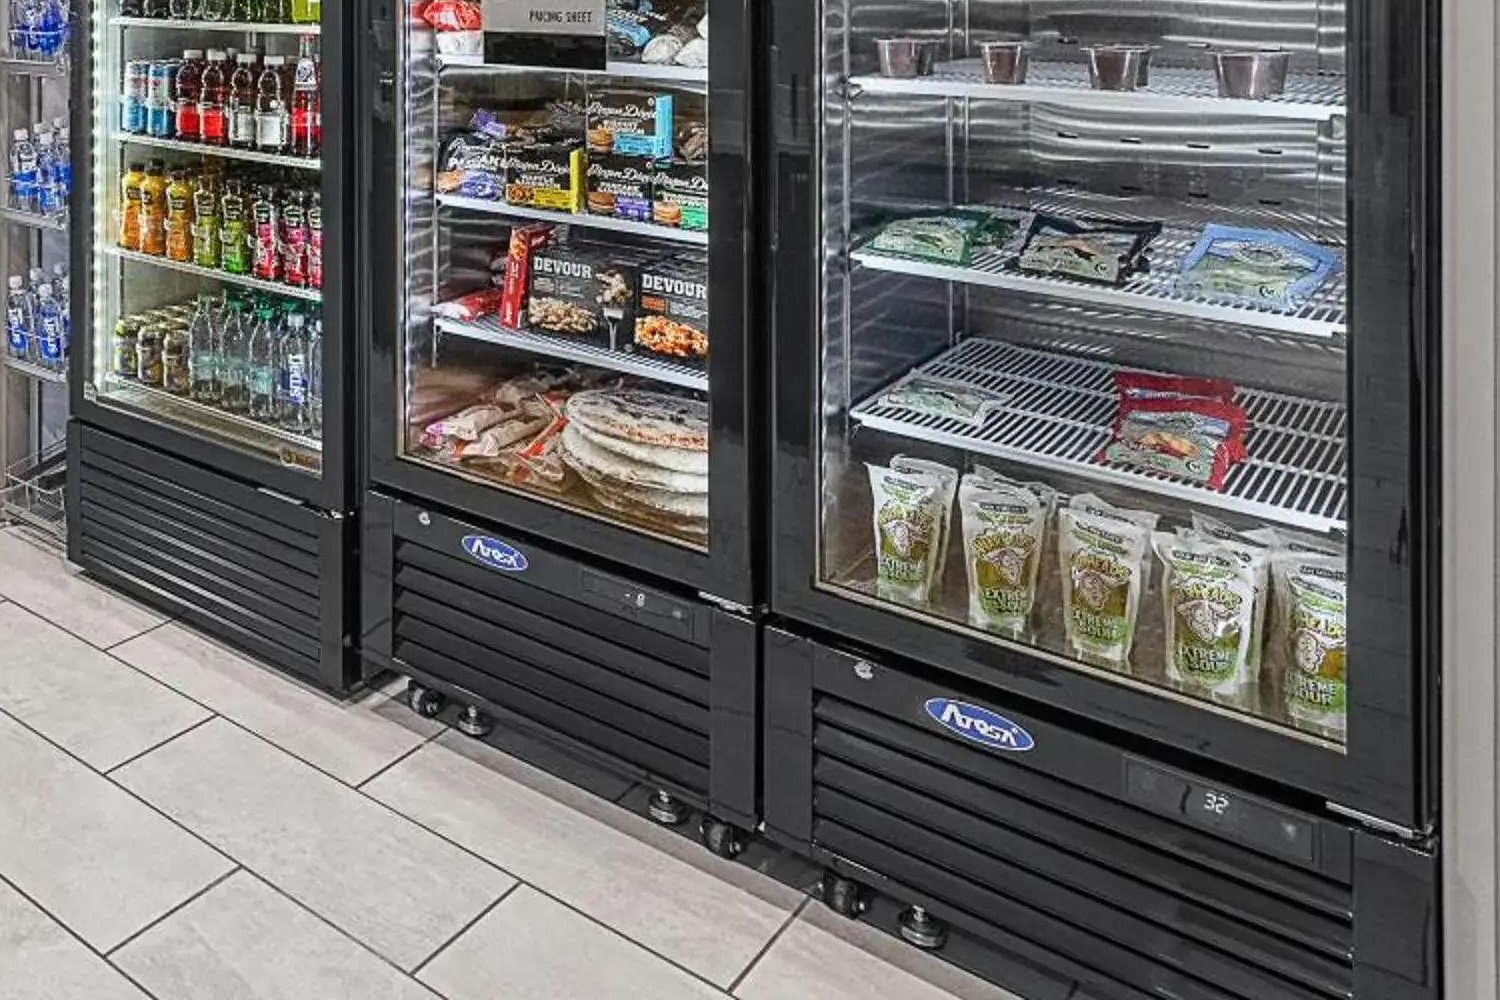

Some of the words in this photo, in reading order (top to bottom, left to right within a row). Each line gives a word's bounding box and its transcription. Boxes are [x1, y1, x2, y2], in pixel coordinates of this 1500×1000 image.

[529, 10, 563, 23] PRICING
[565, 11, 593, 23] SHEET
[533, 256, 594, 279] DEVOUR
[642, 273, 707, 299] DEVOUR
[1203, 792, 1230, 814] 32
